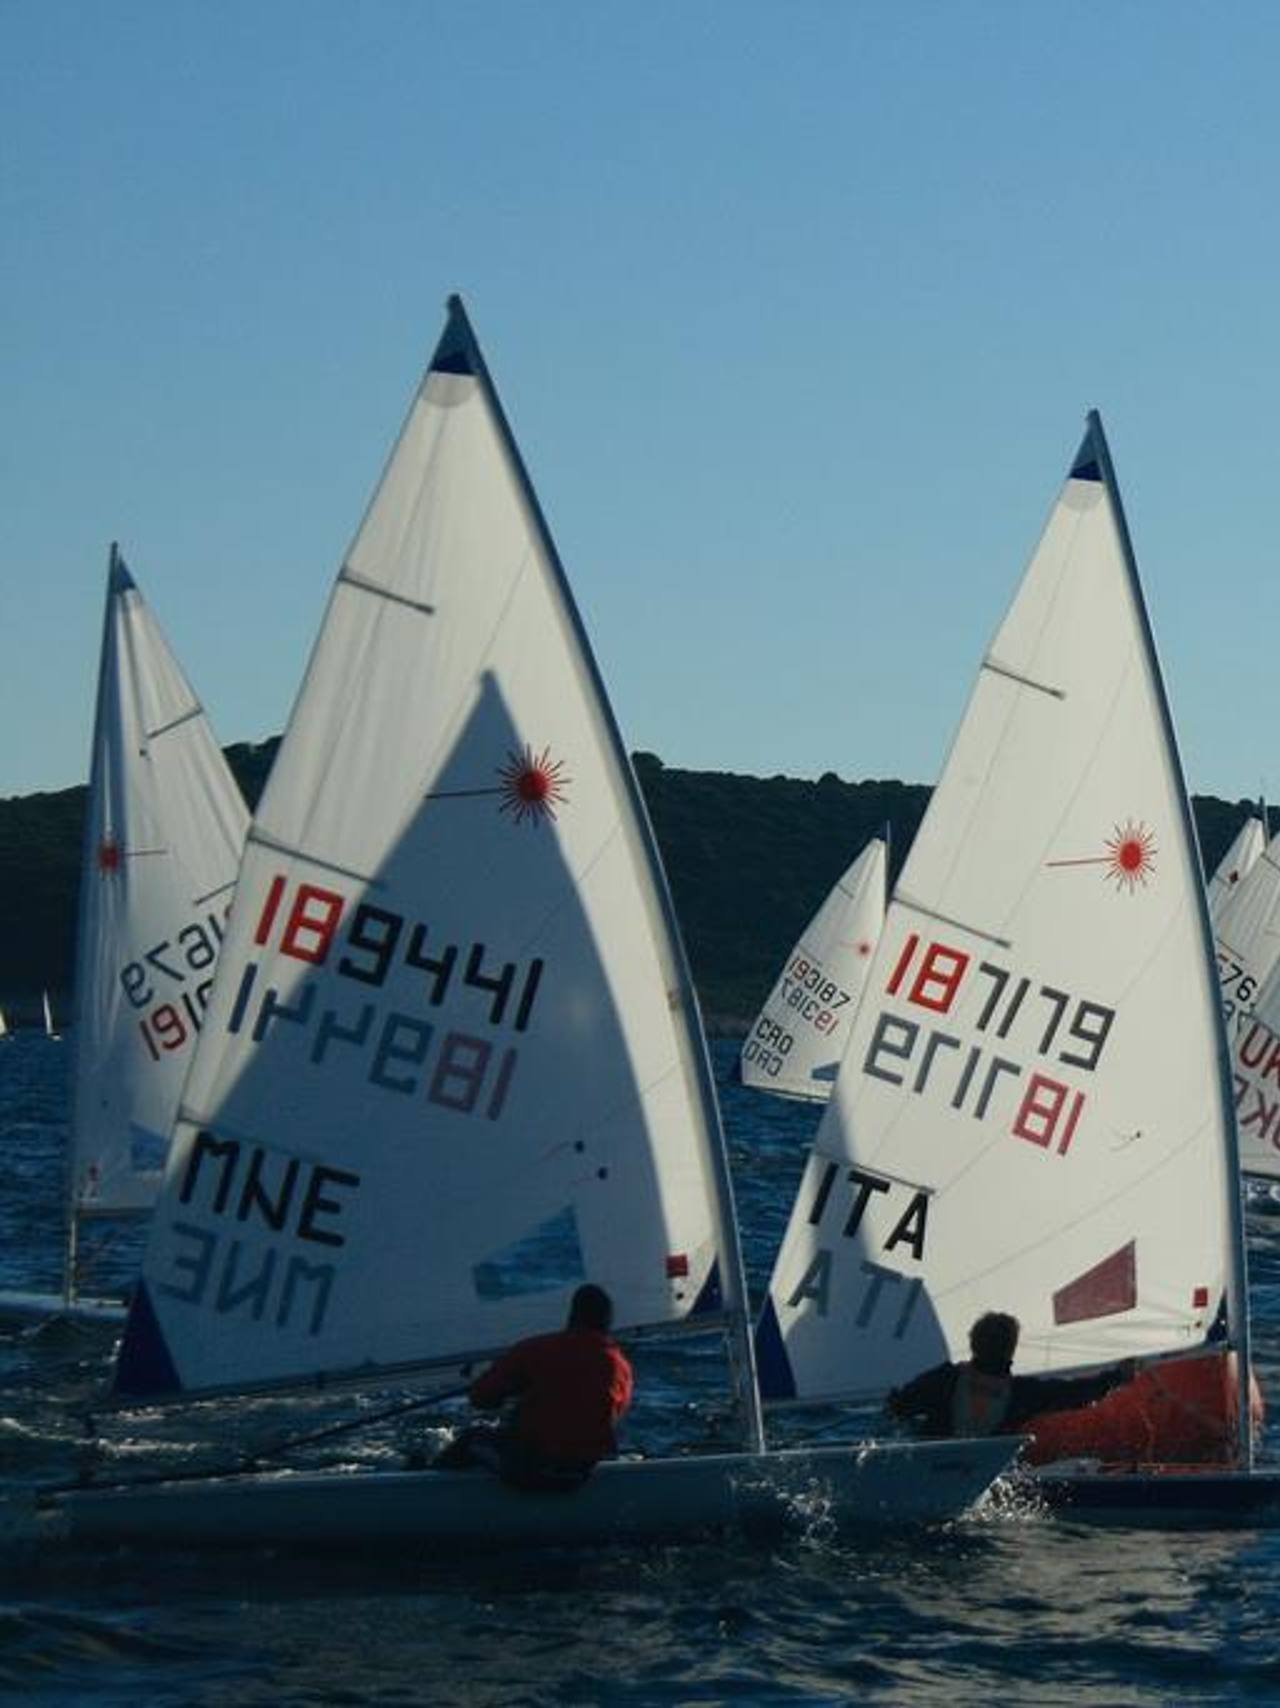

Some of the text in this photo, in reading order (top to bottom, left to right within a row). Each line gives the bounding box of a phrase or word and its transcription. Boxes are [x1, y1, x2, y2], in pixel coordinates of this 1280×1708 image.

[254, 875, 543, 1032] 189441
[886, 933, 1116, 1072] 187179
[756, 1017, 794, 1055] CRO
[178, 1131, 361, 1248] MNE
[808, 1162, 930, 1260] ITA
